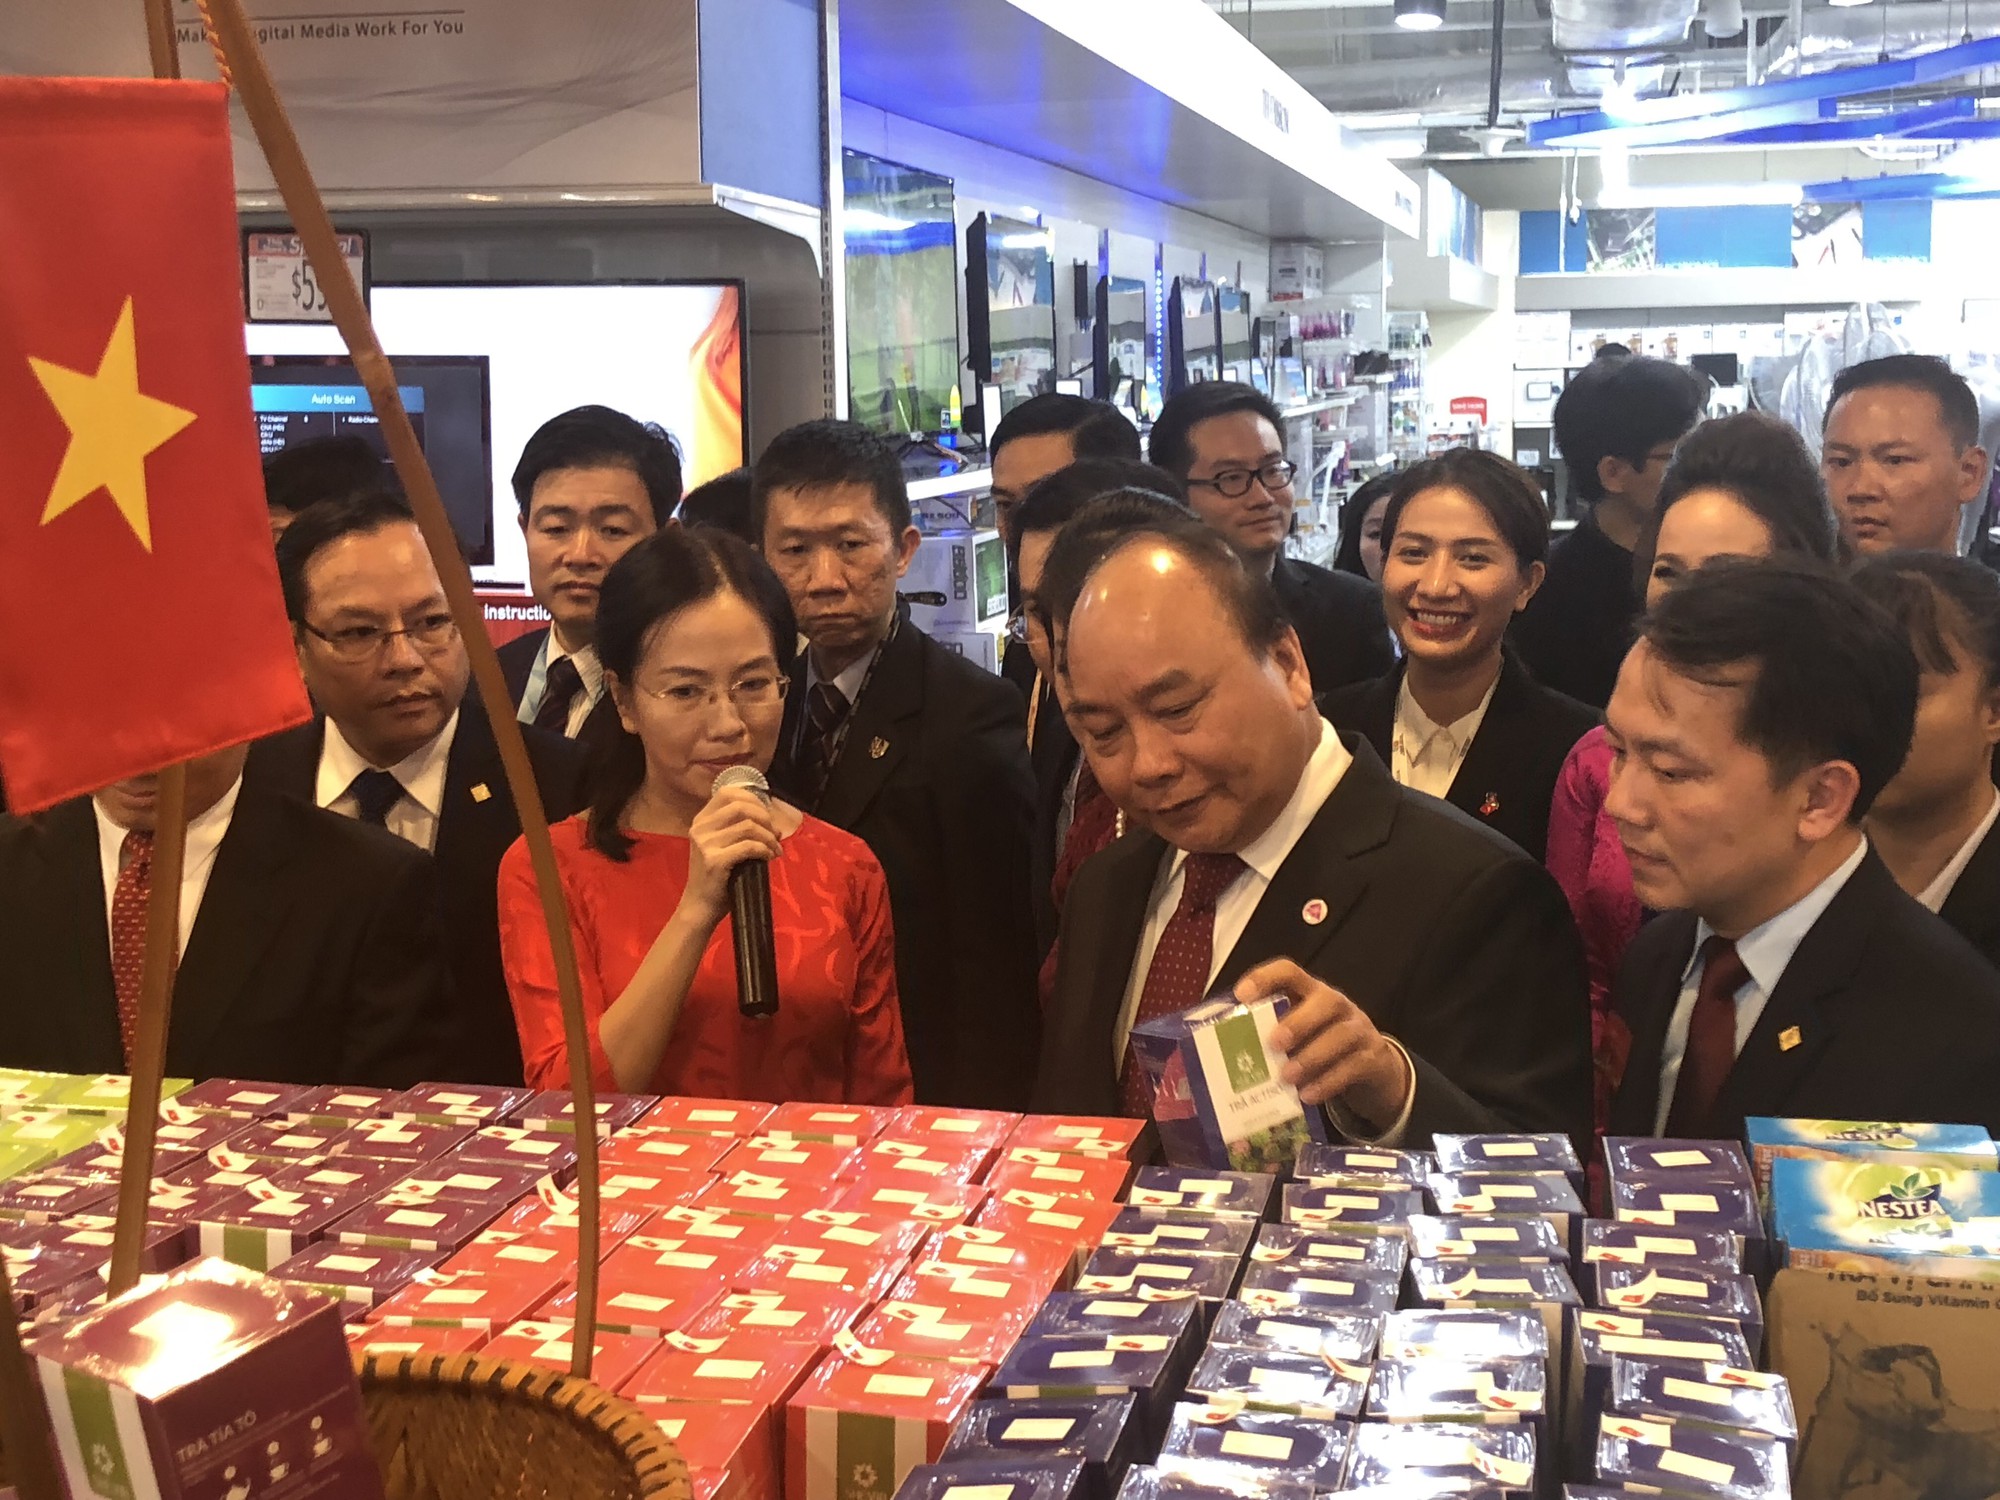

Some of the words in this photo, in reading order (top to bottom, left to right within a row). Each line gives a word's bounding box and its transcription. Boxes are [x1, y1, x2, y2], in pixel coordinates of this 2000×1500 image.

[301, 22, 350, 39] Media
[355, 21, 397, 37] Work
[402, 20, 429, 35] For
[434, 19, 463, 34] You
[311, 393, 333, 405] Auto
[333, 394, 356, 405] Scan
[484, 602, 552, 621] Instructio
[1857, 1200, 1945, 1218] NESTEA
[1882, 1291, 1923, 1307] Sung
[1928, 1293, 1990, 1309] Vitamin
